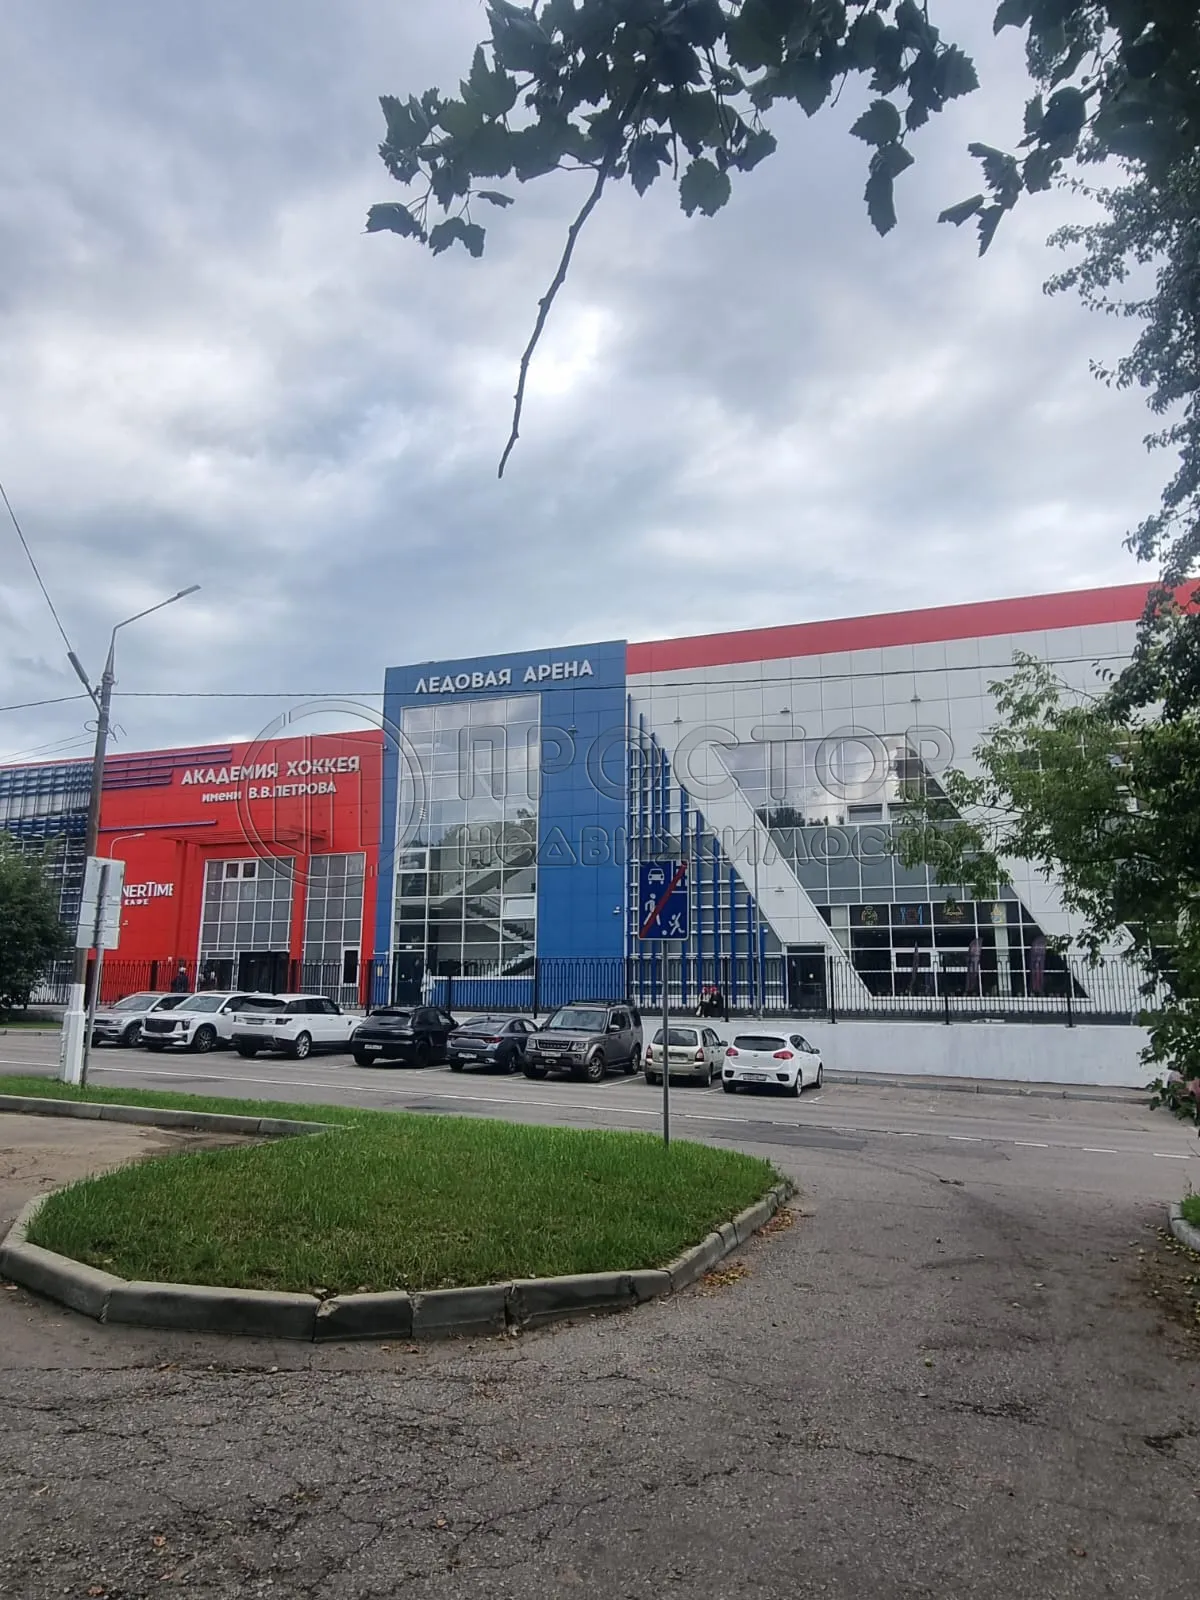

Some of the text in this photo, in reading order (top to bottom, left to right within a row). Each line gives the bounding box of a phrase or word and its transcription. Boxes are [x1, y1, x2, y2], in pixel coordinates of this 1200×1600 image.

[414, 659, 593, 694] ЛЕДОВАЯ АРЕНА
[181, 755, 360, 785] АКАДЕМИЯ ХОККЕЯ
[201, 790, 241, 804] имени
